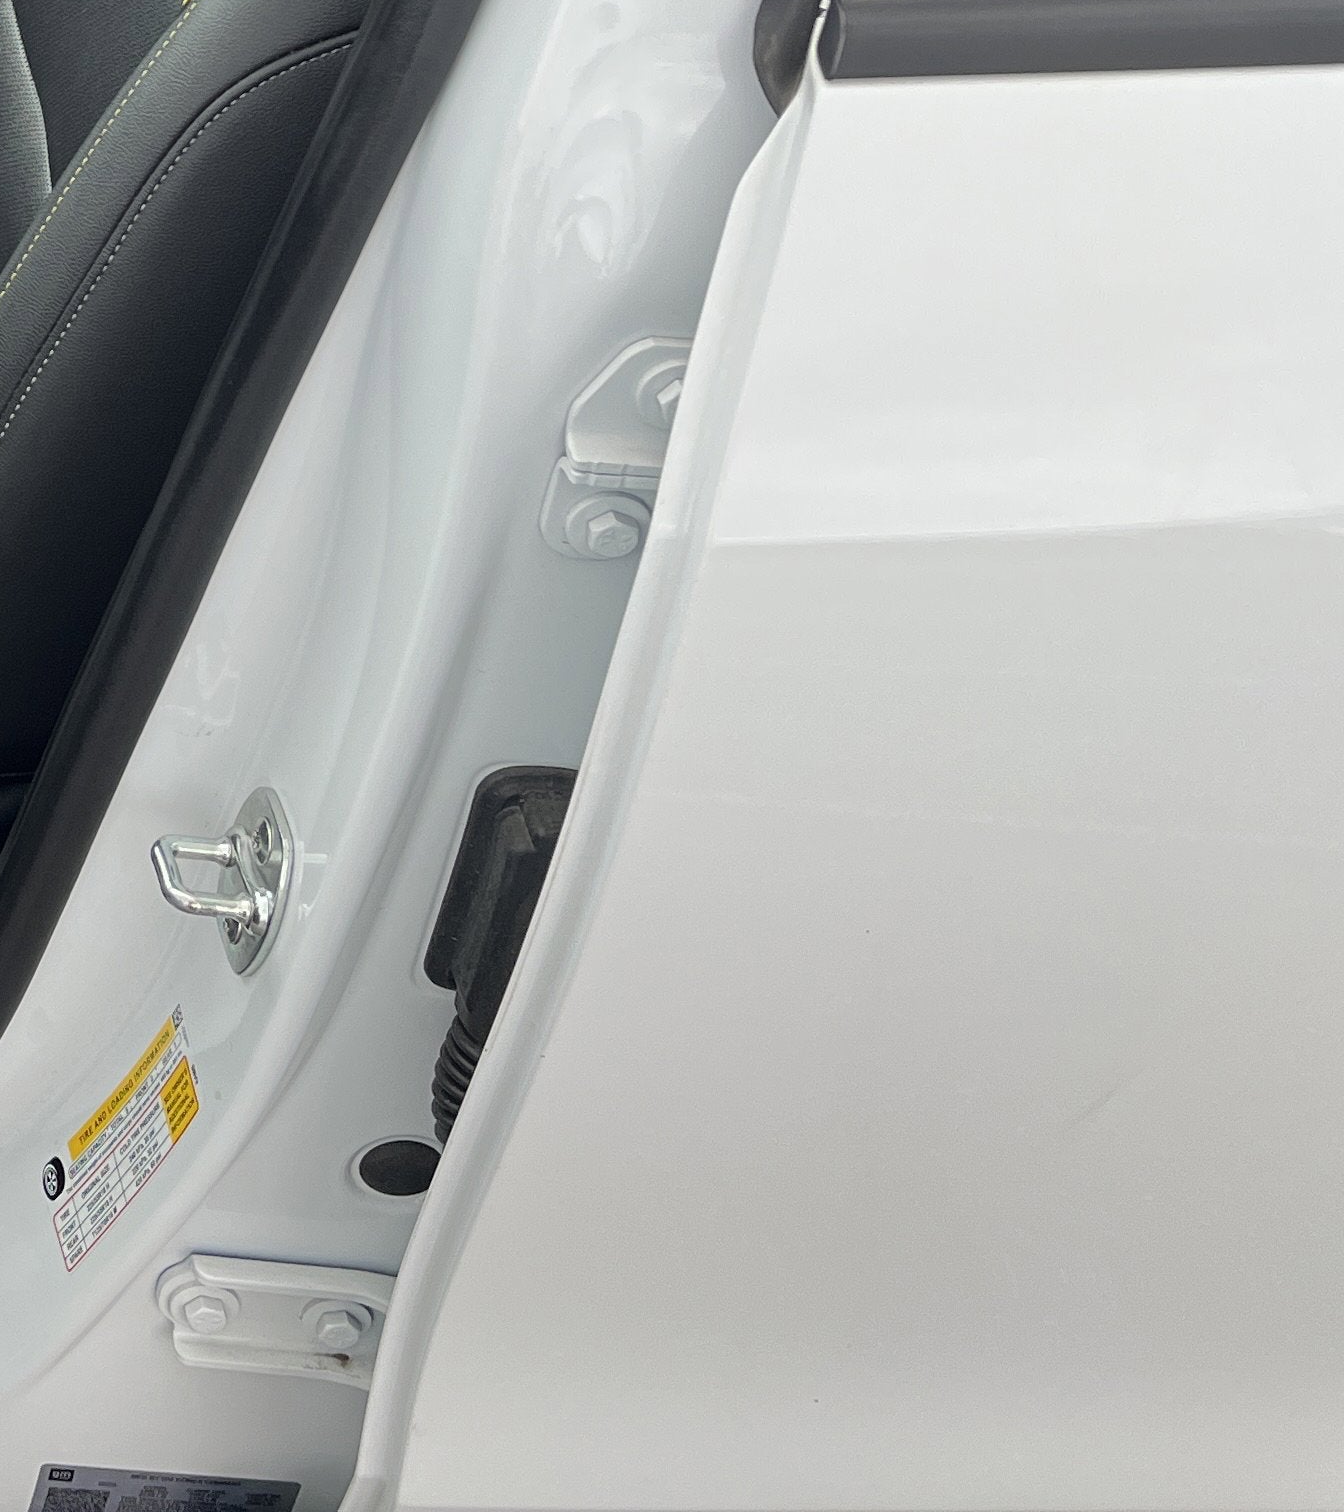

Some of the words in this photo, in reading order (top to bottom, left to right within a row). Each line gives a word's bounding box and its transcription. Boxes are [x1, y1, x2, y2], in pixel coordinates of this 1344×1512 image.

[79, 1126, 92, 1144] TIRE
[94, 1110, 106, 1127] AND
[107, 1078, 132, 1112] LOADING
[134, 1032, 169, 1079] INFORMATION
